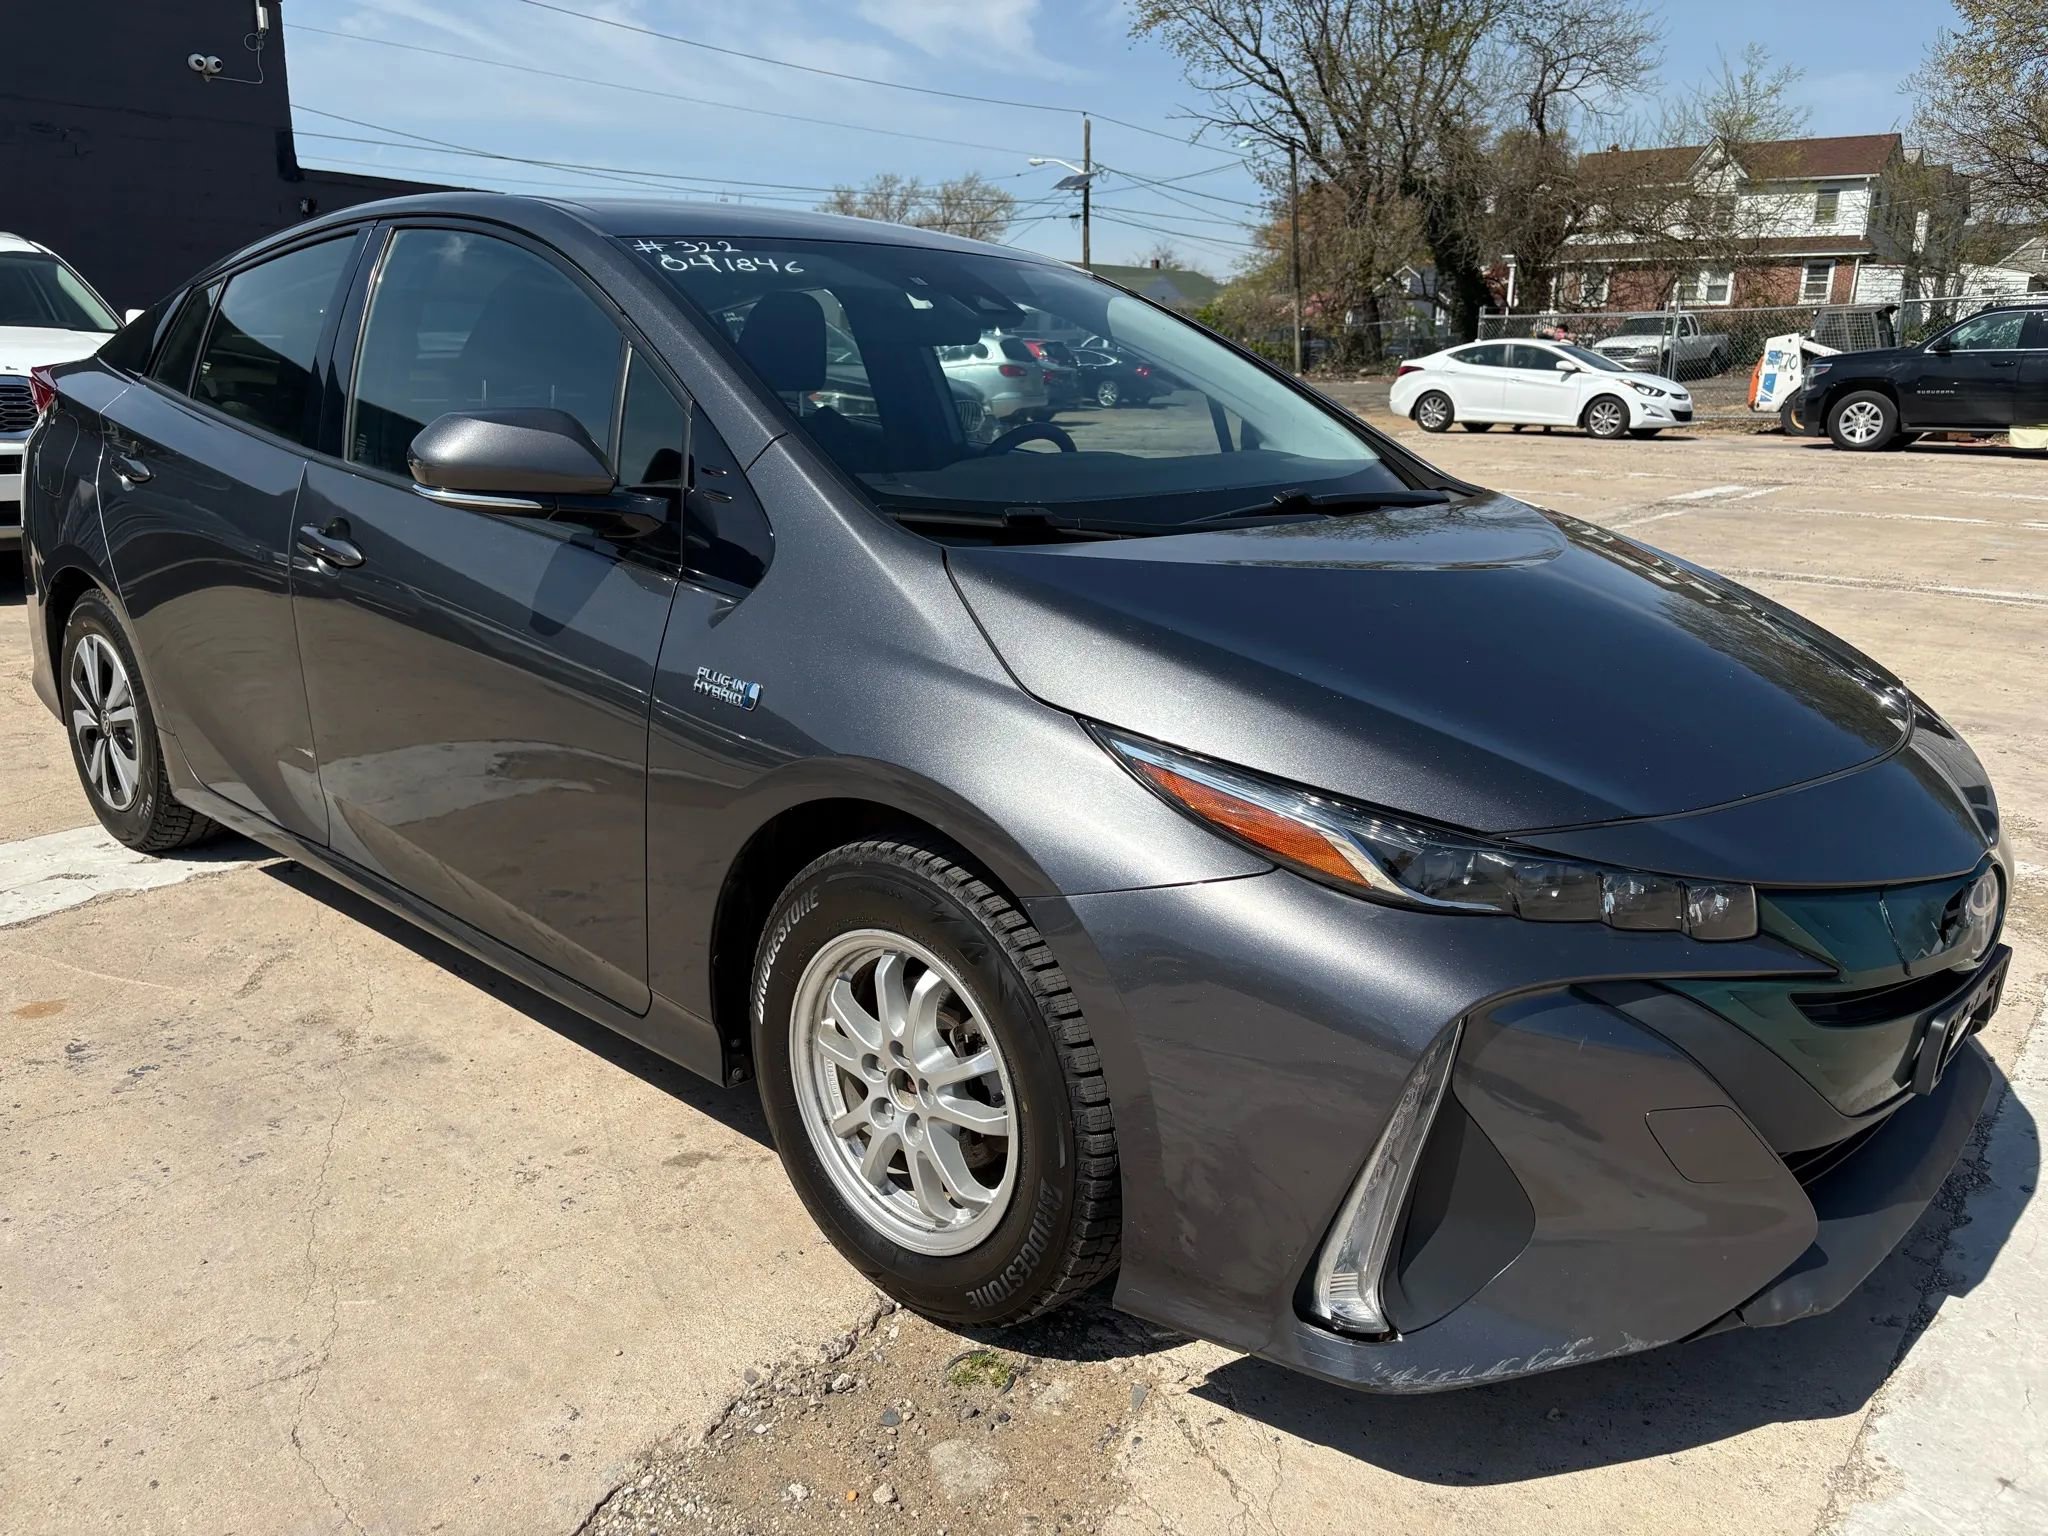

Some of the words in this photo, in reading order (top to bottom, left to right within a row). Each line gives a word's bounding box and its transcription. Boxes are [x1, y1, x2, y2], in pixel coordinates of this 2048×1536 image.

[660, 254, 804, 273] 041846
[693, 678, 744, 707] HYBRID
[697, 666, 748, 693] PLUG-IN
[754, 885, 819, 1025] BRIDGESTONE
[965, 1176, 1064, 1311] BRIDGESTONE
